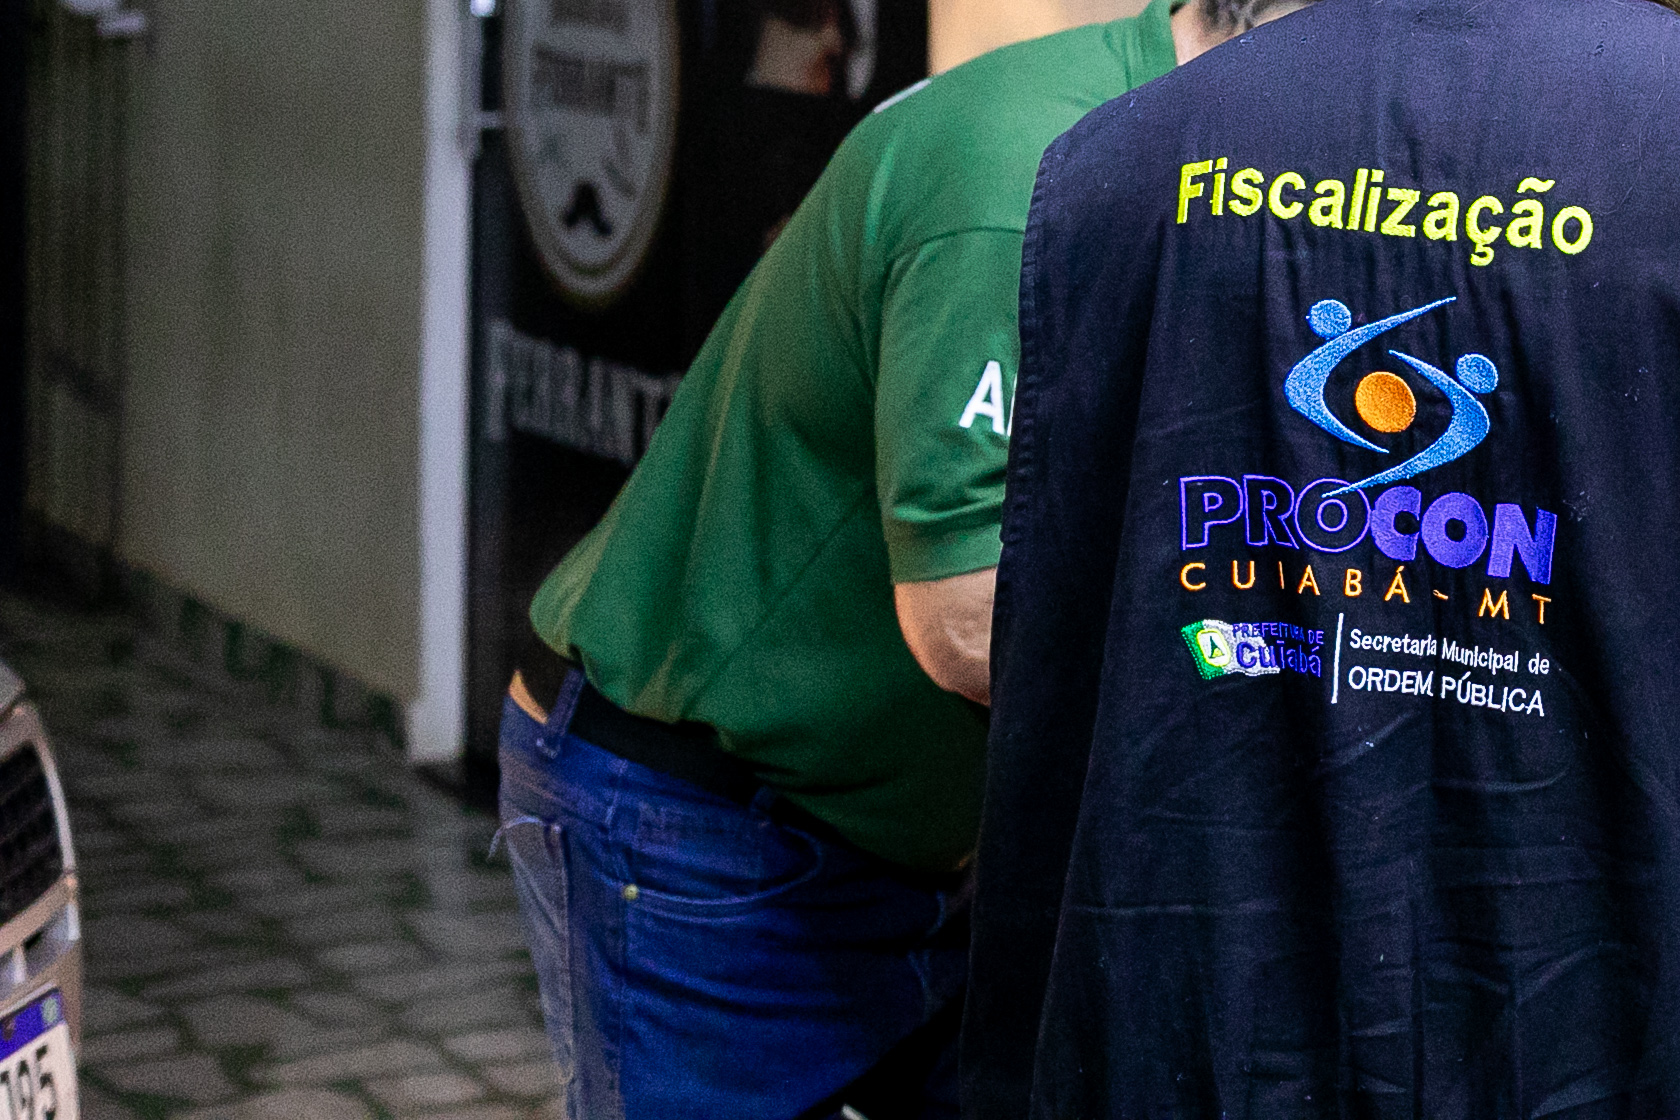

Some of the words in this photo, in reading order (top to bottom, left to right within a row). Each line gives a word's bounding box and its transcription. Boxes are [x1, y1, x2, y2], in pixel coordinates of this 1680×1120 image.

[1176, 157, 1594, 267] Fiscalização
[958, 360, 1018, 437] A
[1179, 474, 1558, 585] PROCON
[1236, 640, 1322, 679] Cuiabá
[1308, 630, 1326, 645] DE
[1350, 628, 1438, 657] Secretaria
[1441, 637, 1519, 676] Municipal
[1528, 652, 1551, 675] de
[1348, 665, 1435, 698] ORDEM
[1440, 671, 1546, 718] PÚBLICA
